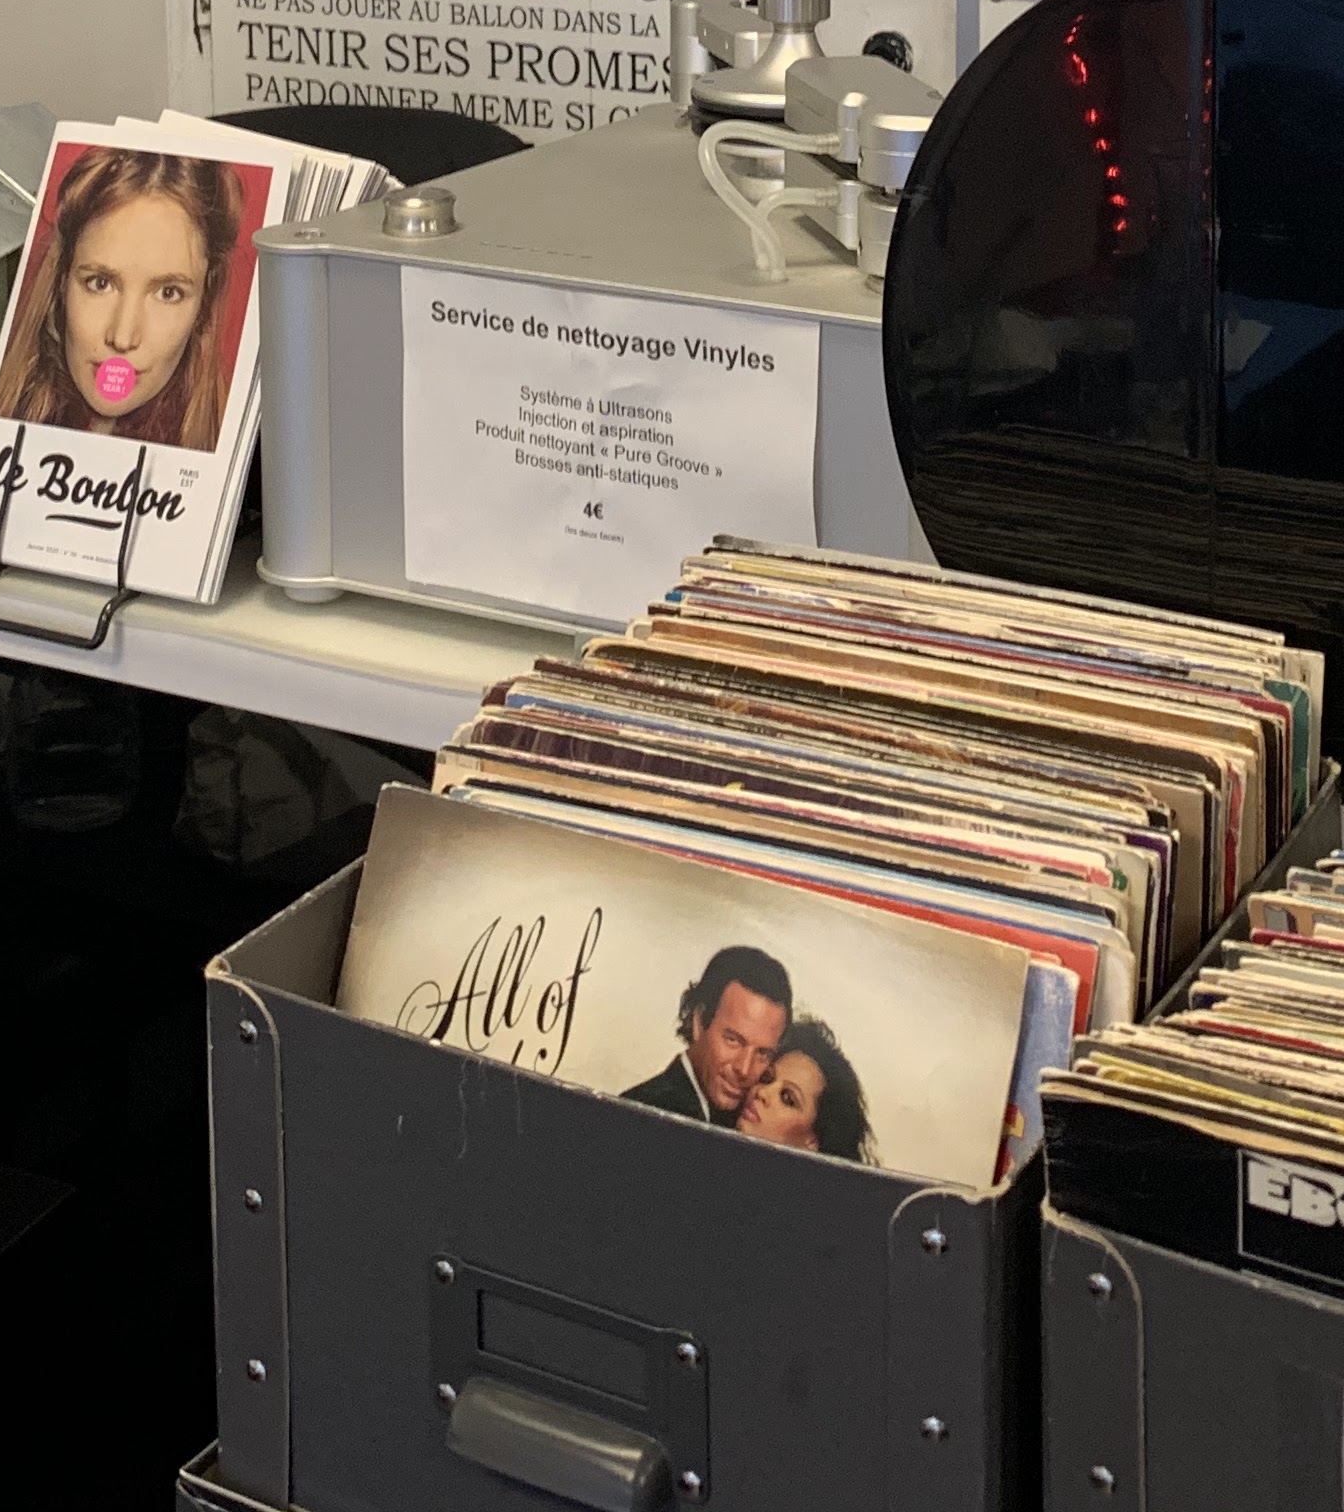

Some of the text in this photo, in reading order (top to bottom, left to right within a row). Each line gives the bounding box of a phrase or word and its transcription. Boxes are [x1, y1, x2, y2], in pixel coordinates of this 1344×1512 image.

[450, 3, 544, 30] BALLON
[553, 8, 621, 35] DANS
[238, 22, 470, 77] TENIR SES
[452, 92, 554, 128] MEME
[431, 300, 775, 373] Service de nettoyage Vinyles
[105, 365, 130, 375] HAPPY
[106, 375, 125, 385] NEW
[519, 384, 673, 424] Système à Ultrasons
[518, 407, 674, 446] Injection et aspiration
[475, 420, 710, 477] Produit nettoyant Pure Groove
[36, 454, 186, 521] Bonbon
[179, 468, 199, 479] PARIS
[180, 479, 194, 488] EST
[515, 449, 679, 492] Brosses anti-statiques
[582, 500, 604, 520] 4€
[396, 907, 602, 1077] All of
